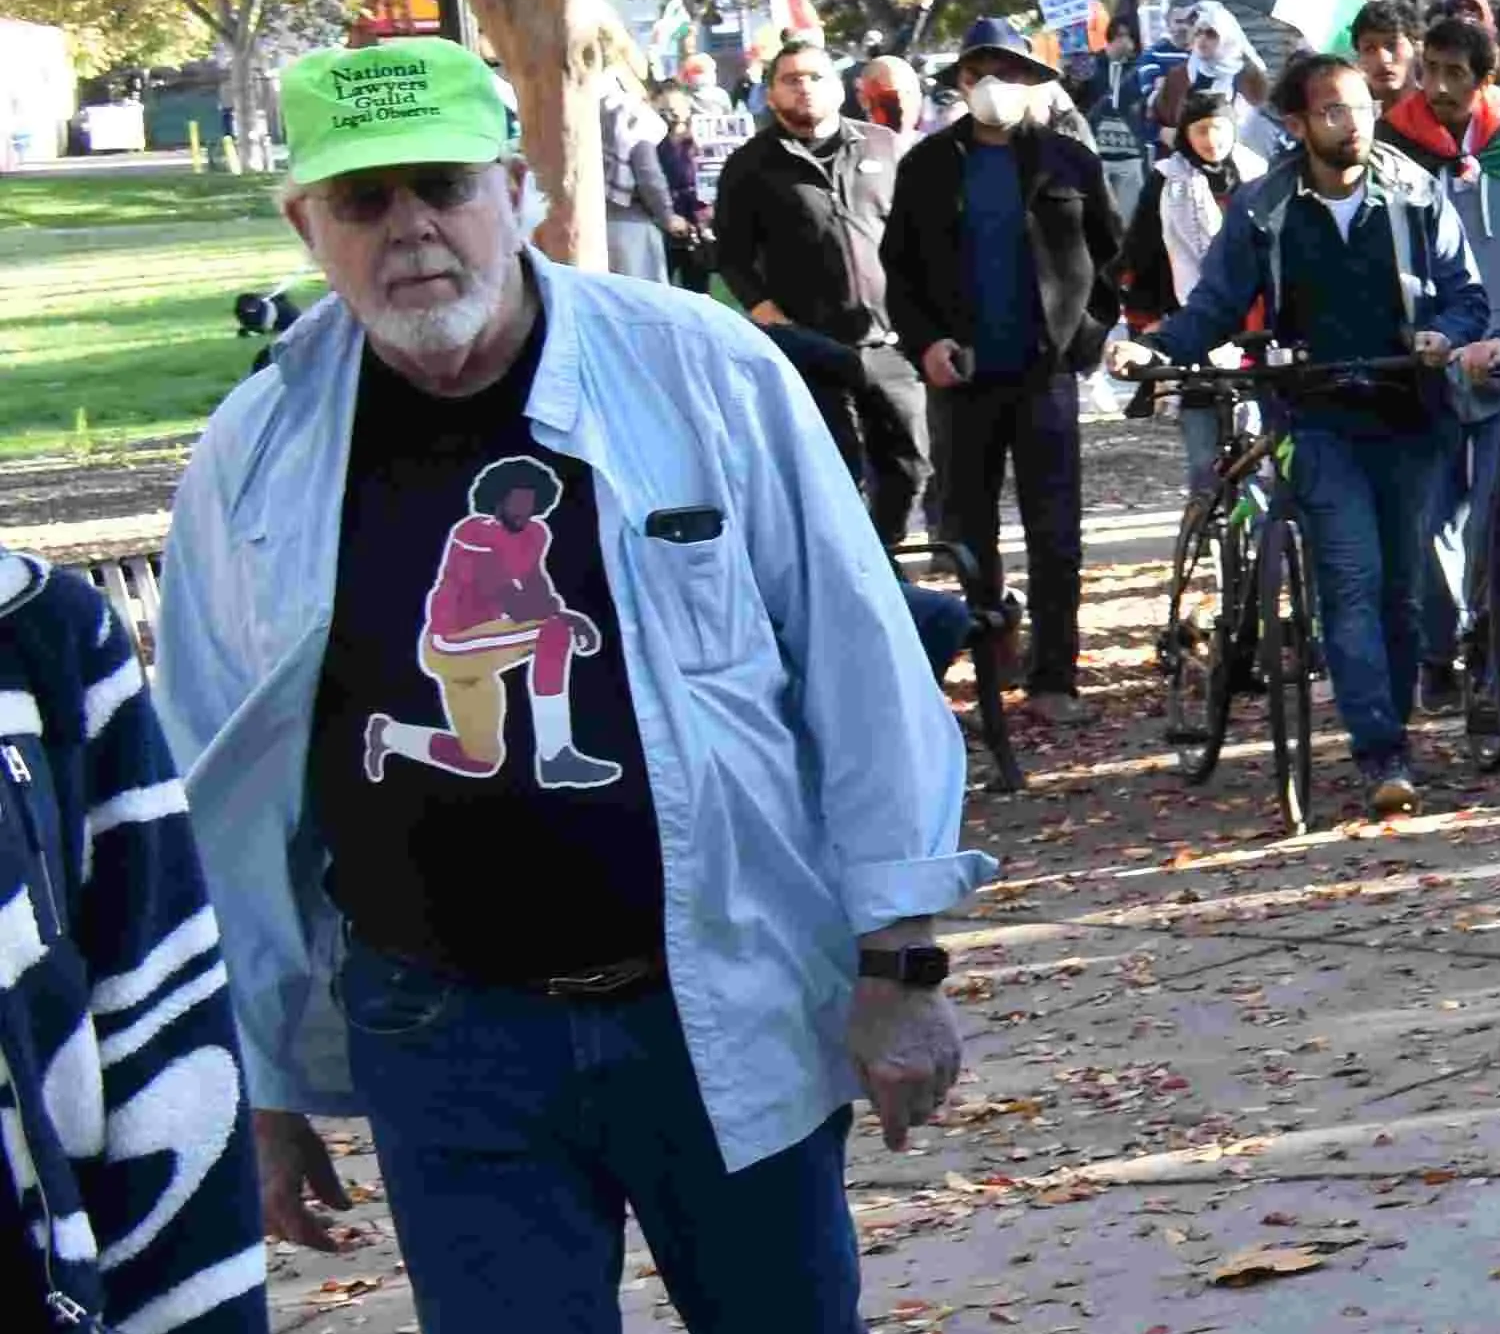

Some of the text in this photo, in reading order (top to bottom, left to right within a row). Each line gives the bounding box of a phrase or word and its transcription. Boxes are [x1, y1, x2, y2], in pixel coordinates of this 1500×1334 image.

[330, 58, 427, 83] National
[336, 79, 428, 100] Lawyers
[354, 91, 418, 109] Guild
[332, 110, 373, 128] Legal
